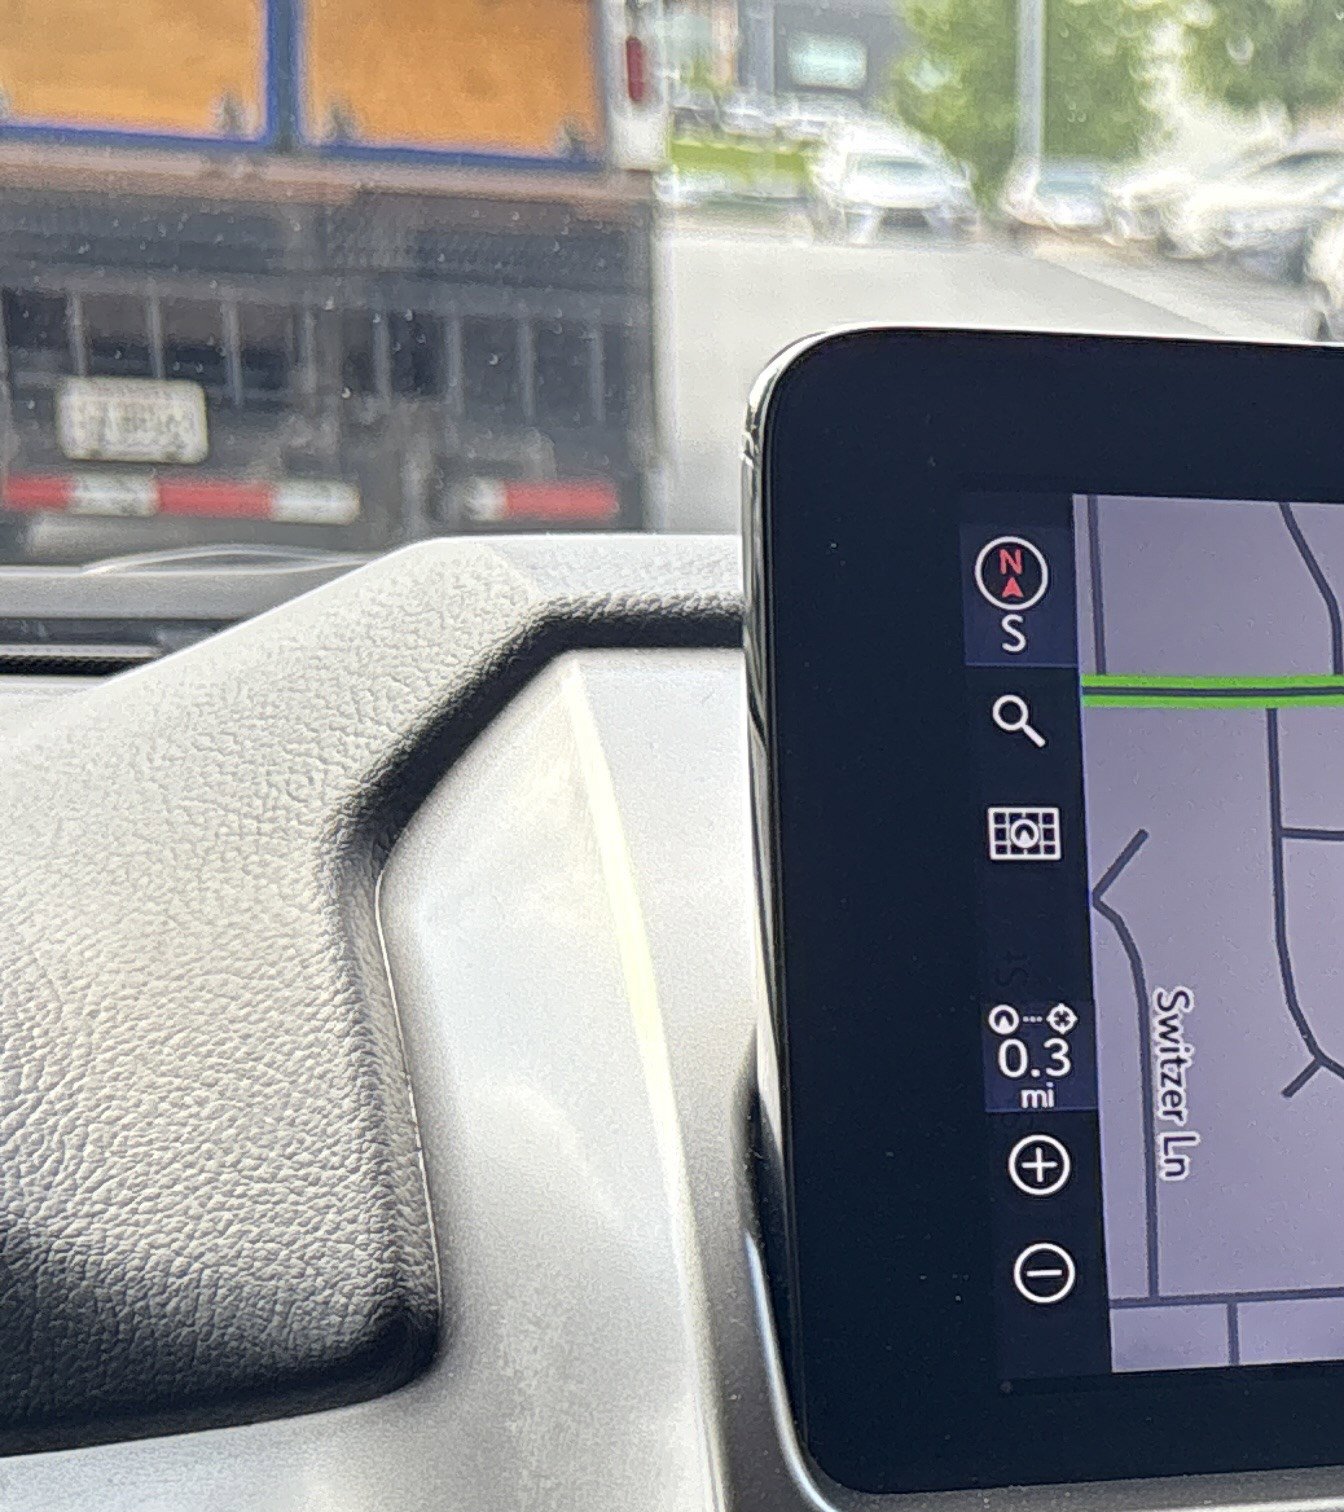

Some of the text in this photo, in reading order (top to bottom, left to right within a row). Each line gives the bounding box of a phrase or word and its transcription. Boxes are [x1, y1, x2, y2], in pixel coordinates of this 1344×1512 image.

[1000, 549, 1021, 575] N
[1001, 615, 1026, 652] S
[998, 1037, 1072, 1080] 0.3
[1021, 1082, 1054, 1108] mi
[1157, 990, 1197, 1178] Switzer Ln
